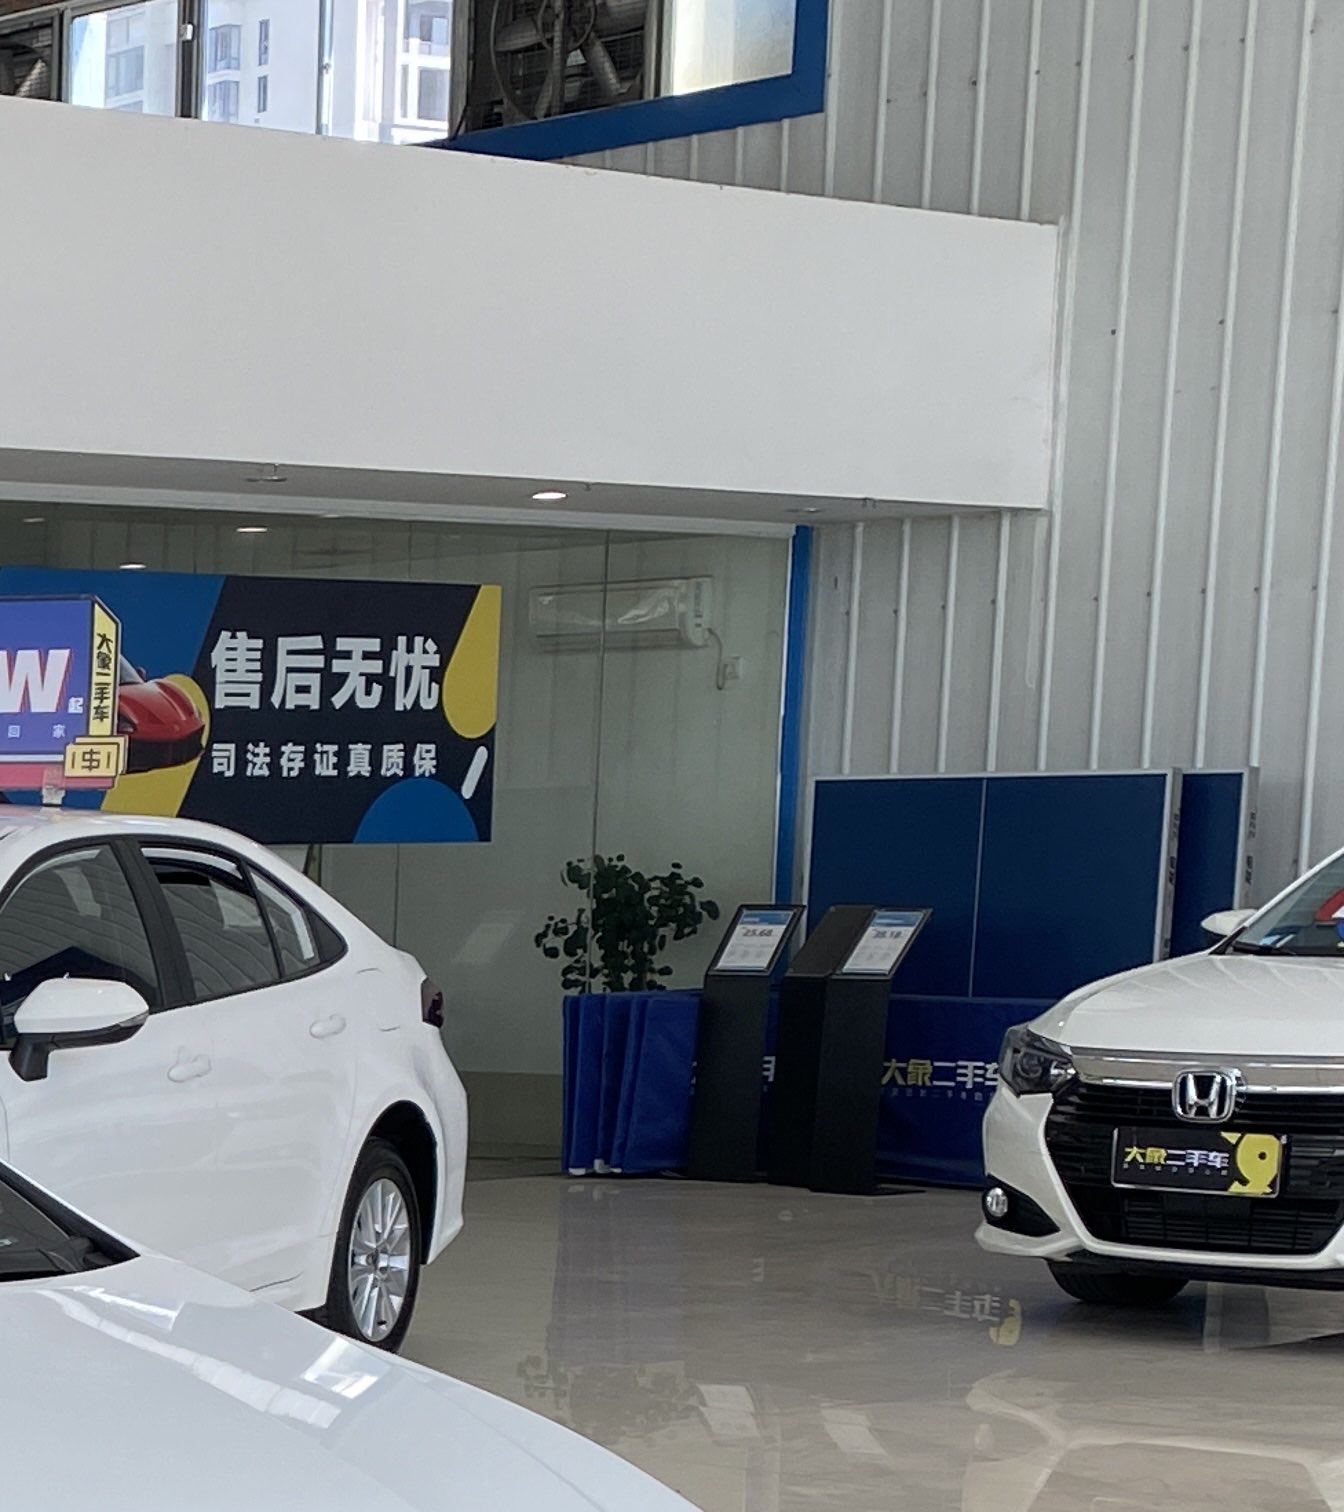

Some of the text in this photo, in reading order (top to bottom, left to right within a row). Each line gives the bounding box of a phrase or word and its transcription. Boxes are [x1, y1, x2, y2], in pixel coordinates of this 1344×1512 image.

[95, 630, 113, 723] 大象二手车
[210, 630, 443, 713] 售后无忧
[210, 741, 439, 778] 司法存证真质保
[881, 1057, 1000, 1089] 大象二手车
[1123, 1145, 1231, 1169] 大象二手车
